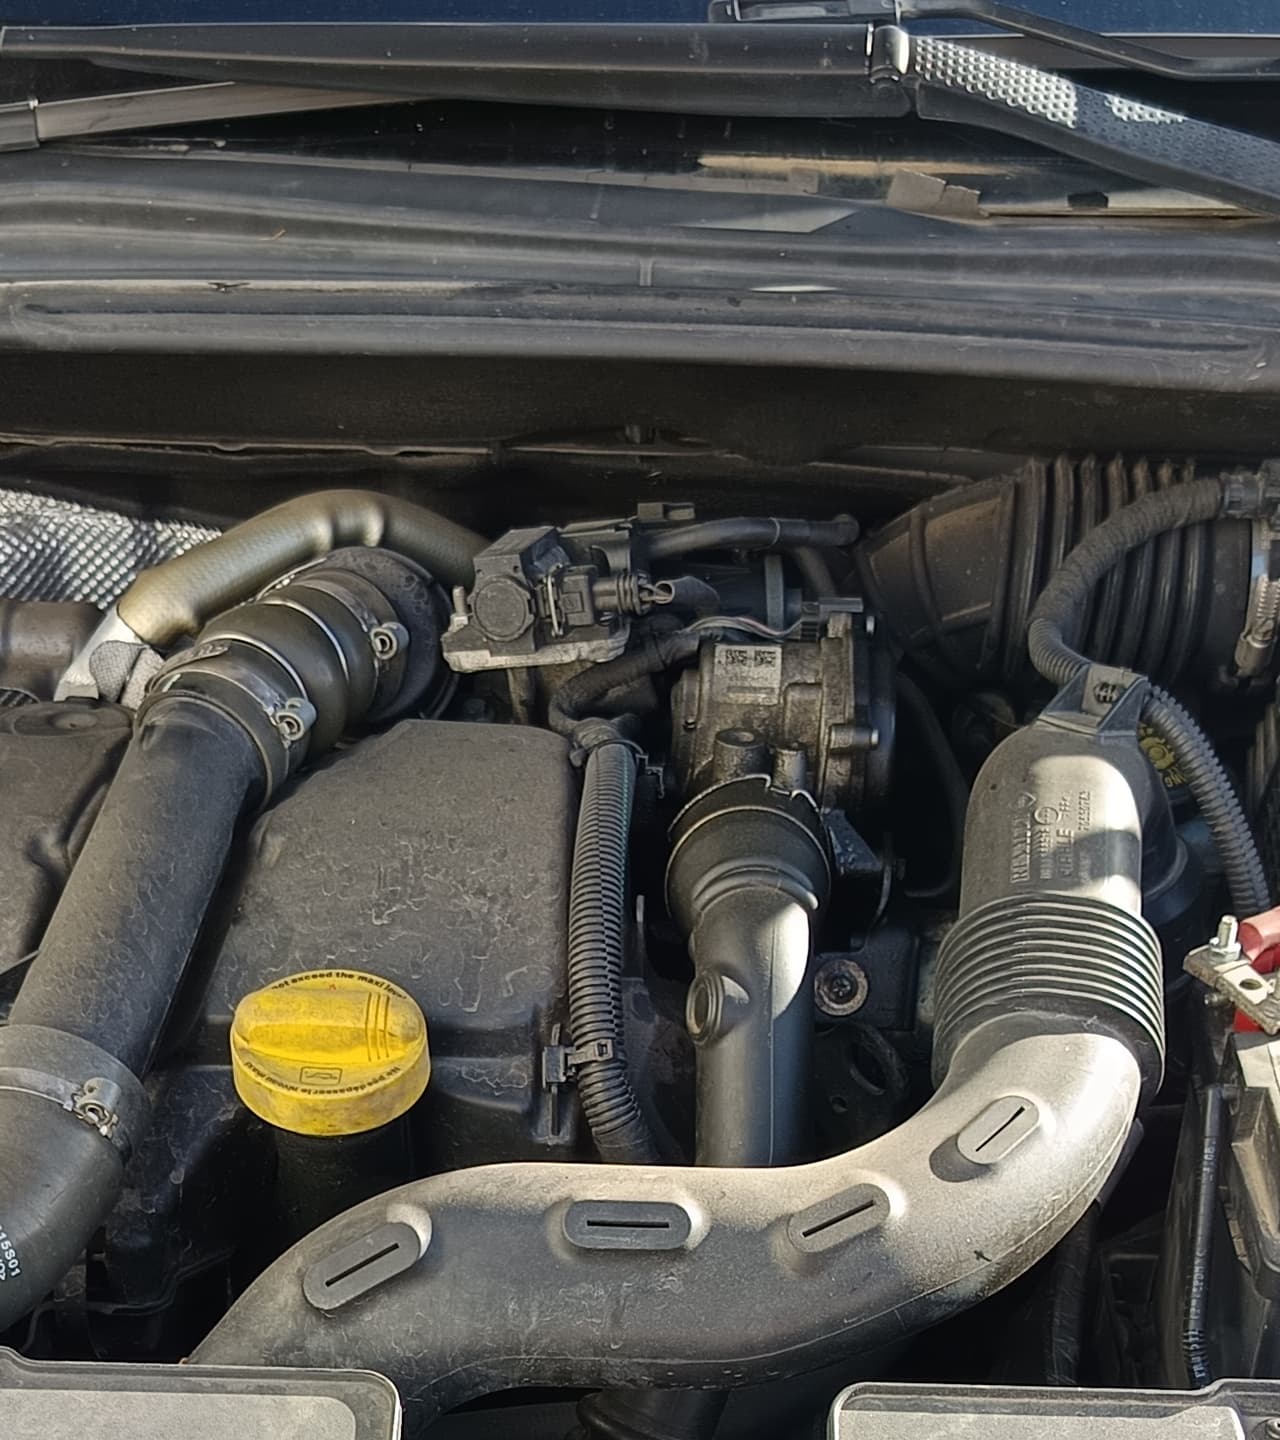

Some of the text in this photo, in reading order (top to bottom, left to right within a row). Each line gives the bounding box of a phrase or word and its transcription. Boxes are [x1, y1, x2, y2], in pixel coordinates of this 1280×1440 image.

[291, 971, 333, 984] exceed
[335, 971, 355, 980] the
[357, 974, 384, 988] maxi
